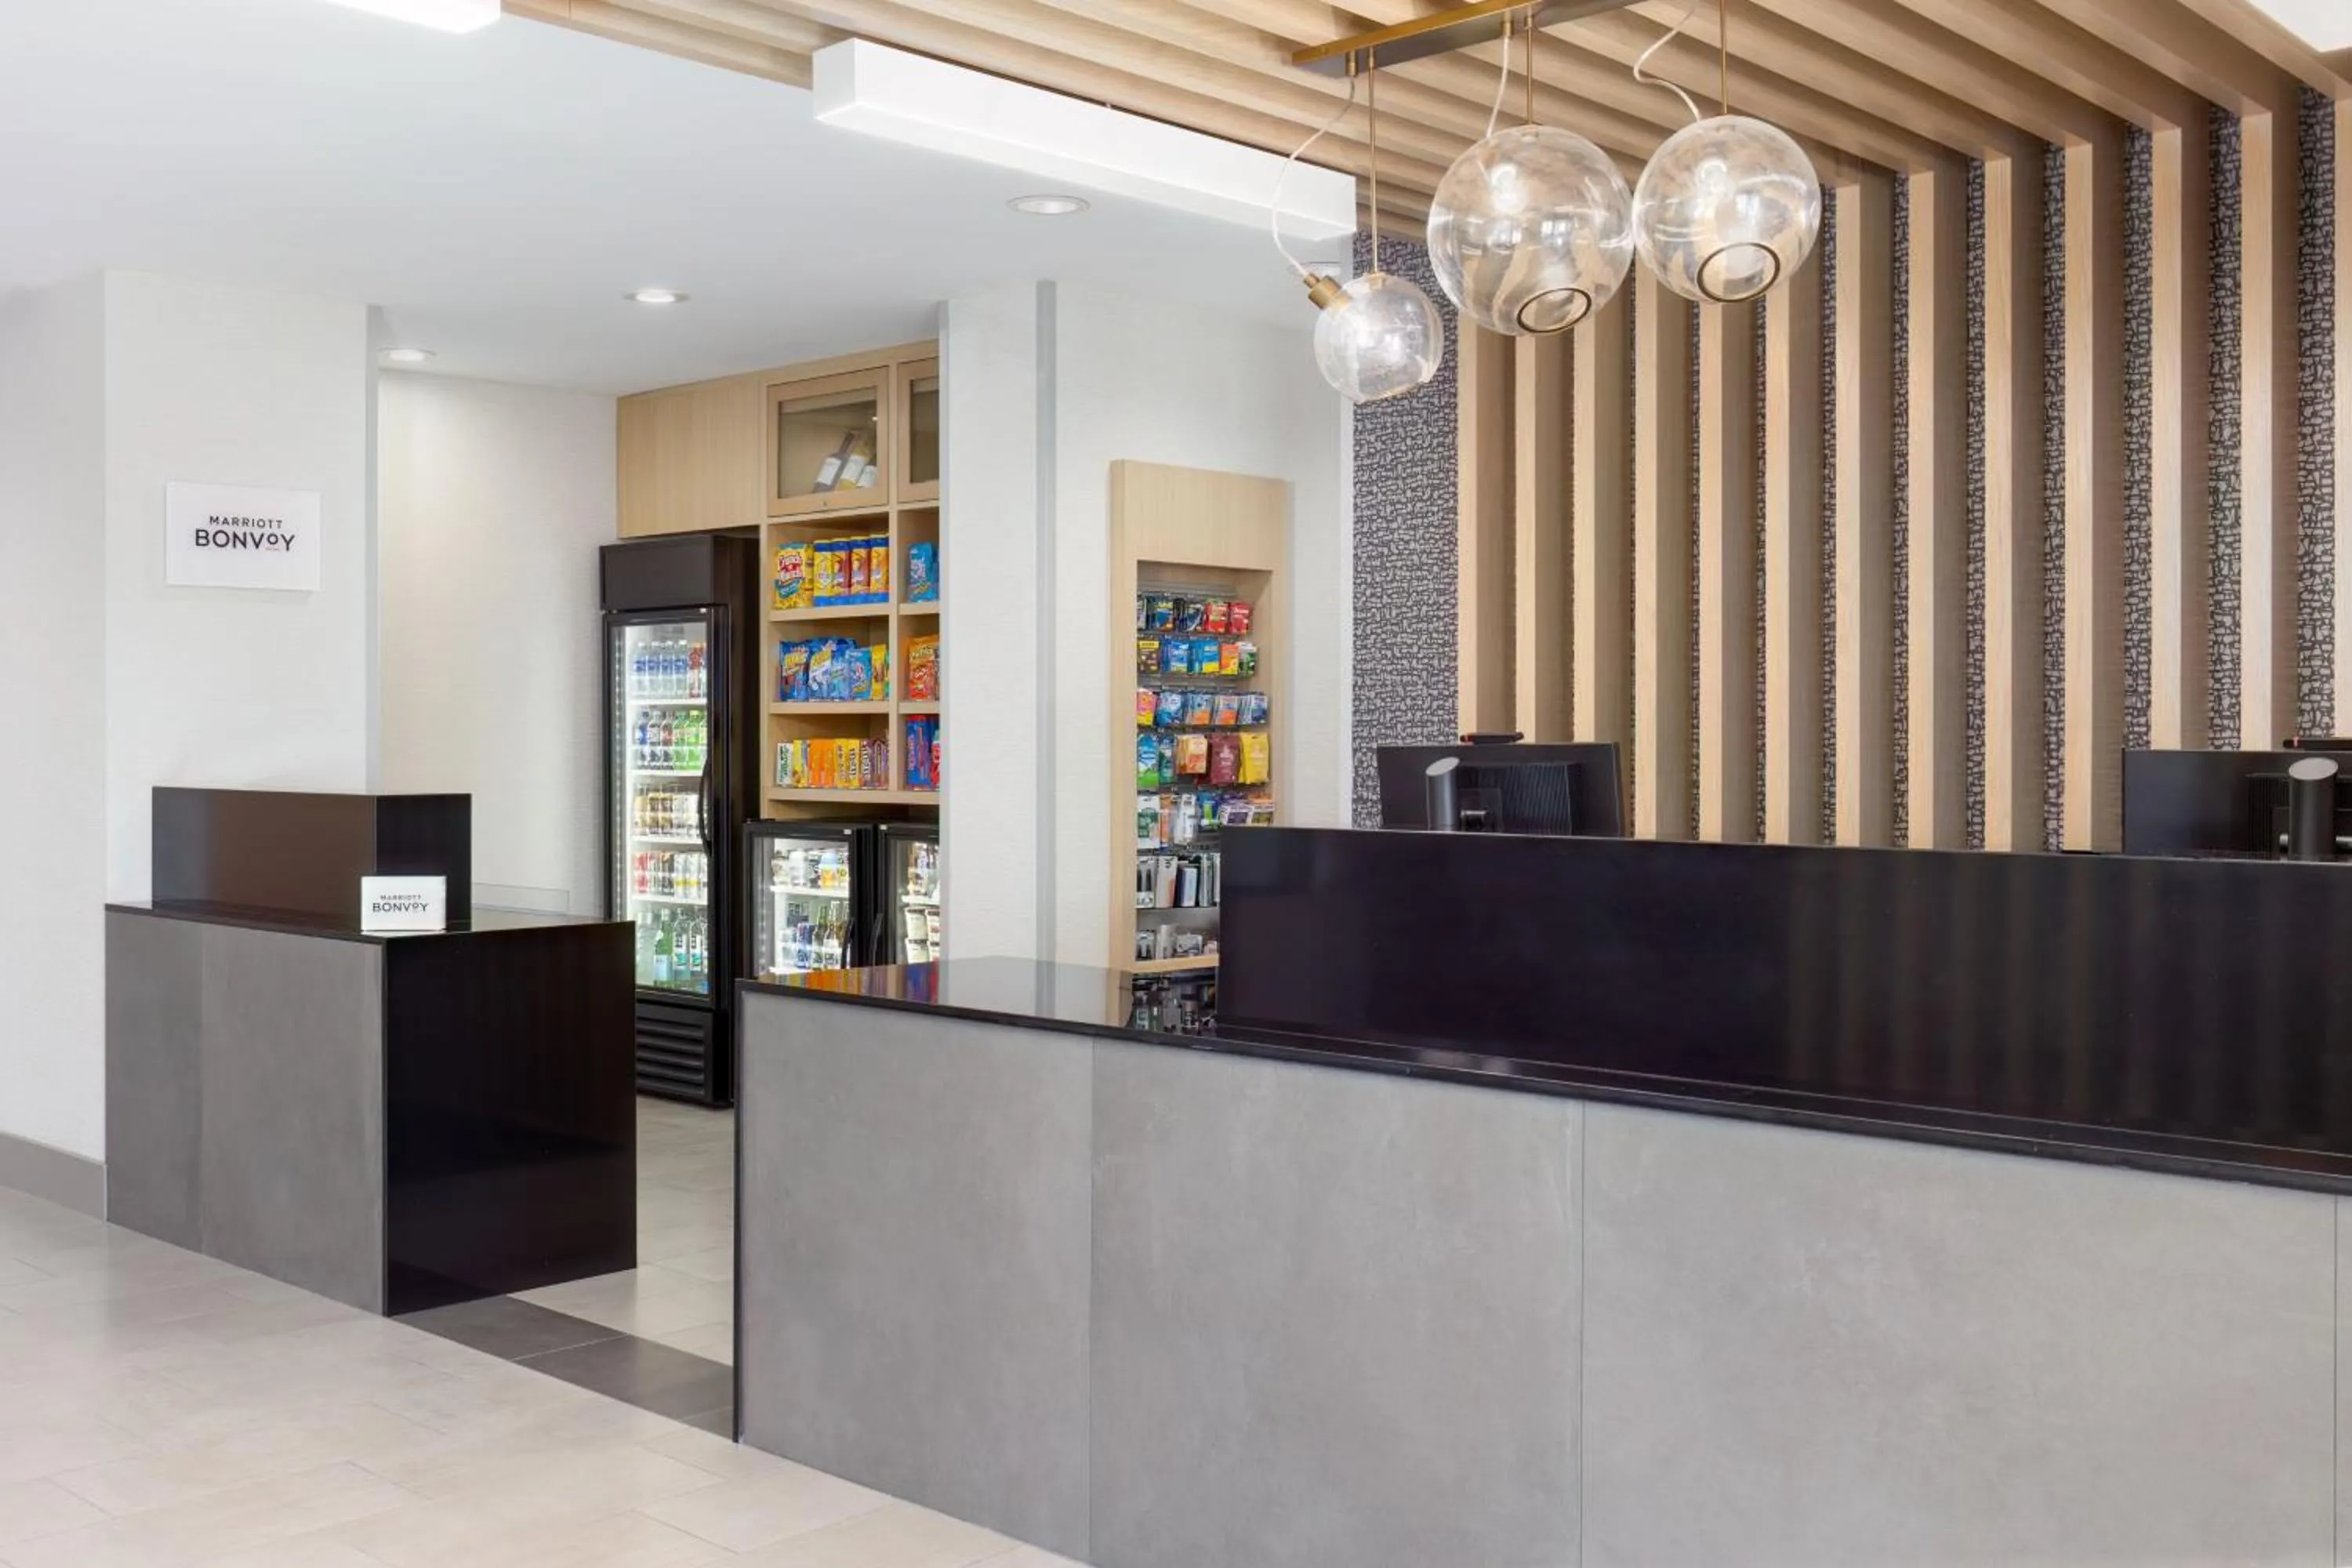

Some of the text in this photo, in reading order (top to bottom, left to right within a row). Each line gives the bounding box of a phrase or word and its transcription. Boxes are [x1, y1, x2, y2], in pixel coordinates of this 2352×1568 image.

[209, 516, 283, 529] MARRIOTT
[195, 528, 296, 551] BONVOY
[372, 902, 429, 912] BONVOY
